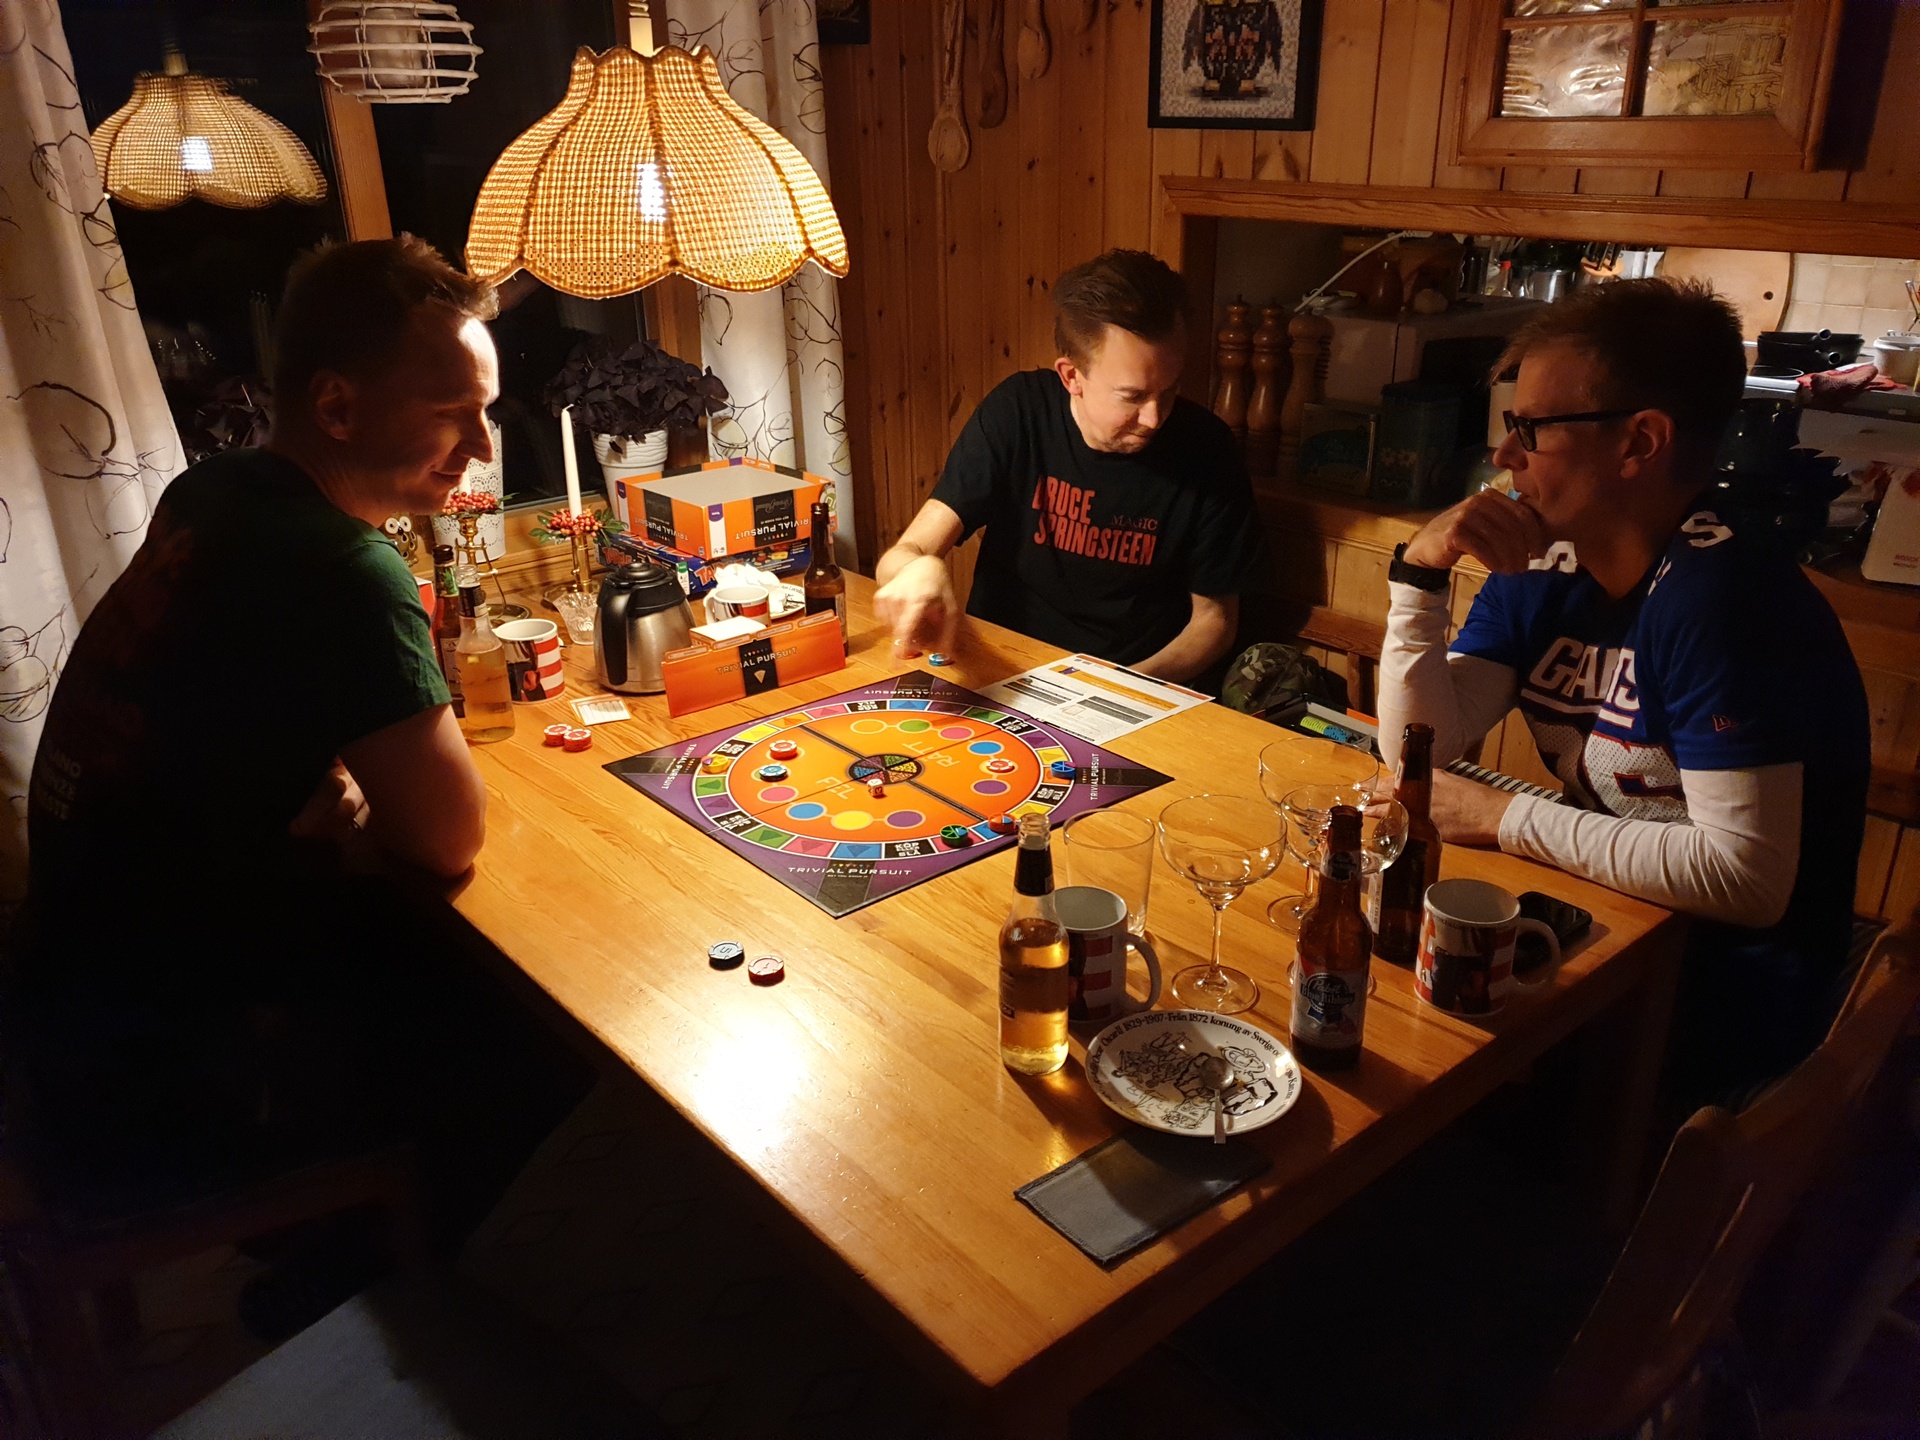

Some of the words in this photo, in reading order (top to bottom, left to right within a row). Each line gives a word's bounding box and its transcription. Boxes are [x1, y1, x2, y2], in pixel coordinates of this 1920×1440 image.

[735, 523, 776, 540] PURSUIT
[775, 518, 812, 532] RIVIAL
[1111, 515, 1159, 531] MAGIC
[1034, 512, 1157, 566] SPRINGSTEEN
[717, 658, 756, 675] TRIVIAL
[757, 647, 798, 665] PURSUIT
[677, 744, 697, 765] TRIVIAL
[1091, 753, 1099, 777] PURSUIT
[661, 764, 683, 789] PURSUIT
[816, 776, 855, 800] FEL
[1090, 777, 1099, 800] TRIVIAL
[1168, 1012, 1188, 1022] Från
[1189, 1013, 1209, 1024] 1872
[1210, 1015, 1243, 1034] konung
[1242, 1028, 1253, 1037] av
[1251, 1031, 1276, 1052] Sverige
